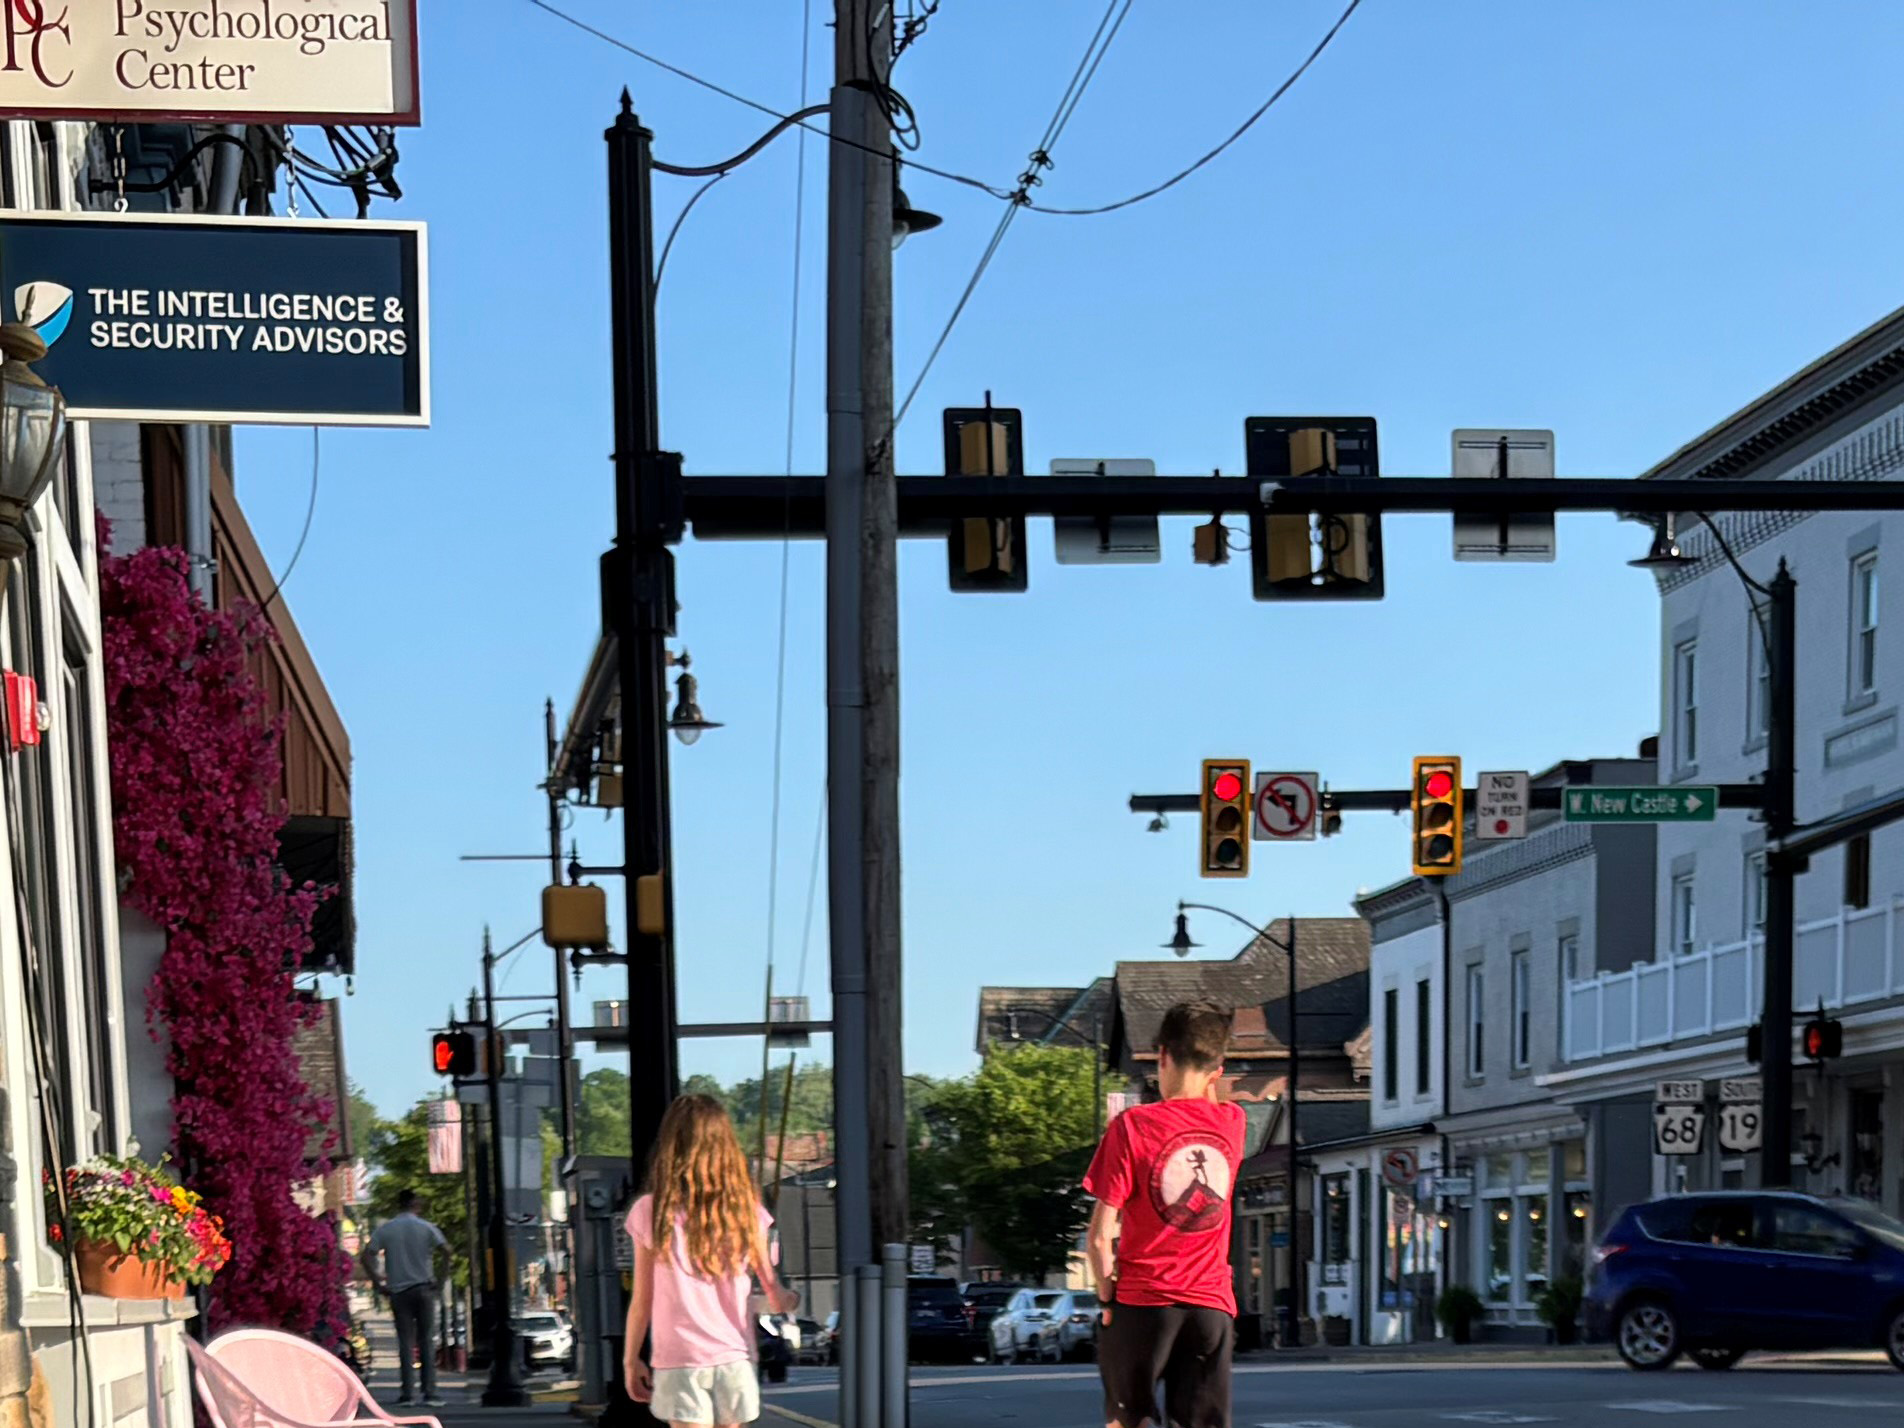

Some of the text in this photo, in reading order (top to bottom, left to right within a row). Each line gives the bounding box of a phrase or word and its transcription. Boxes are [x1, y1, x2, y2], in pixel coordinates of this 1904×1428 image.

[114, 0, 392, 55] Psychological
[116, 48, 256, 91] Center
[88, 288, 404, 324] THE INTELLIGENCE &
[90, 321, 408, 356] SECURITY ADVISORS
[1491, 776, 1515, 789] NO
[1487, 792, 1519, 803] TURN
[1590, 793, 1627, 814] New
[1631, 791, 1679, 814] Castle
[1662, 1083, 1698, 1098] WEST
[1724, 1081, 1762, 1097] SOUT
[1662, 1115, 1696, 1143] 68
[1730, 1113, 1758, 1140] 19
